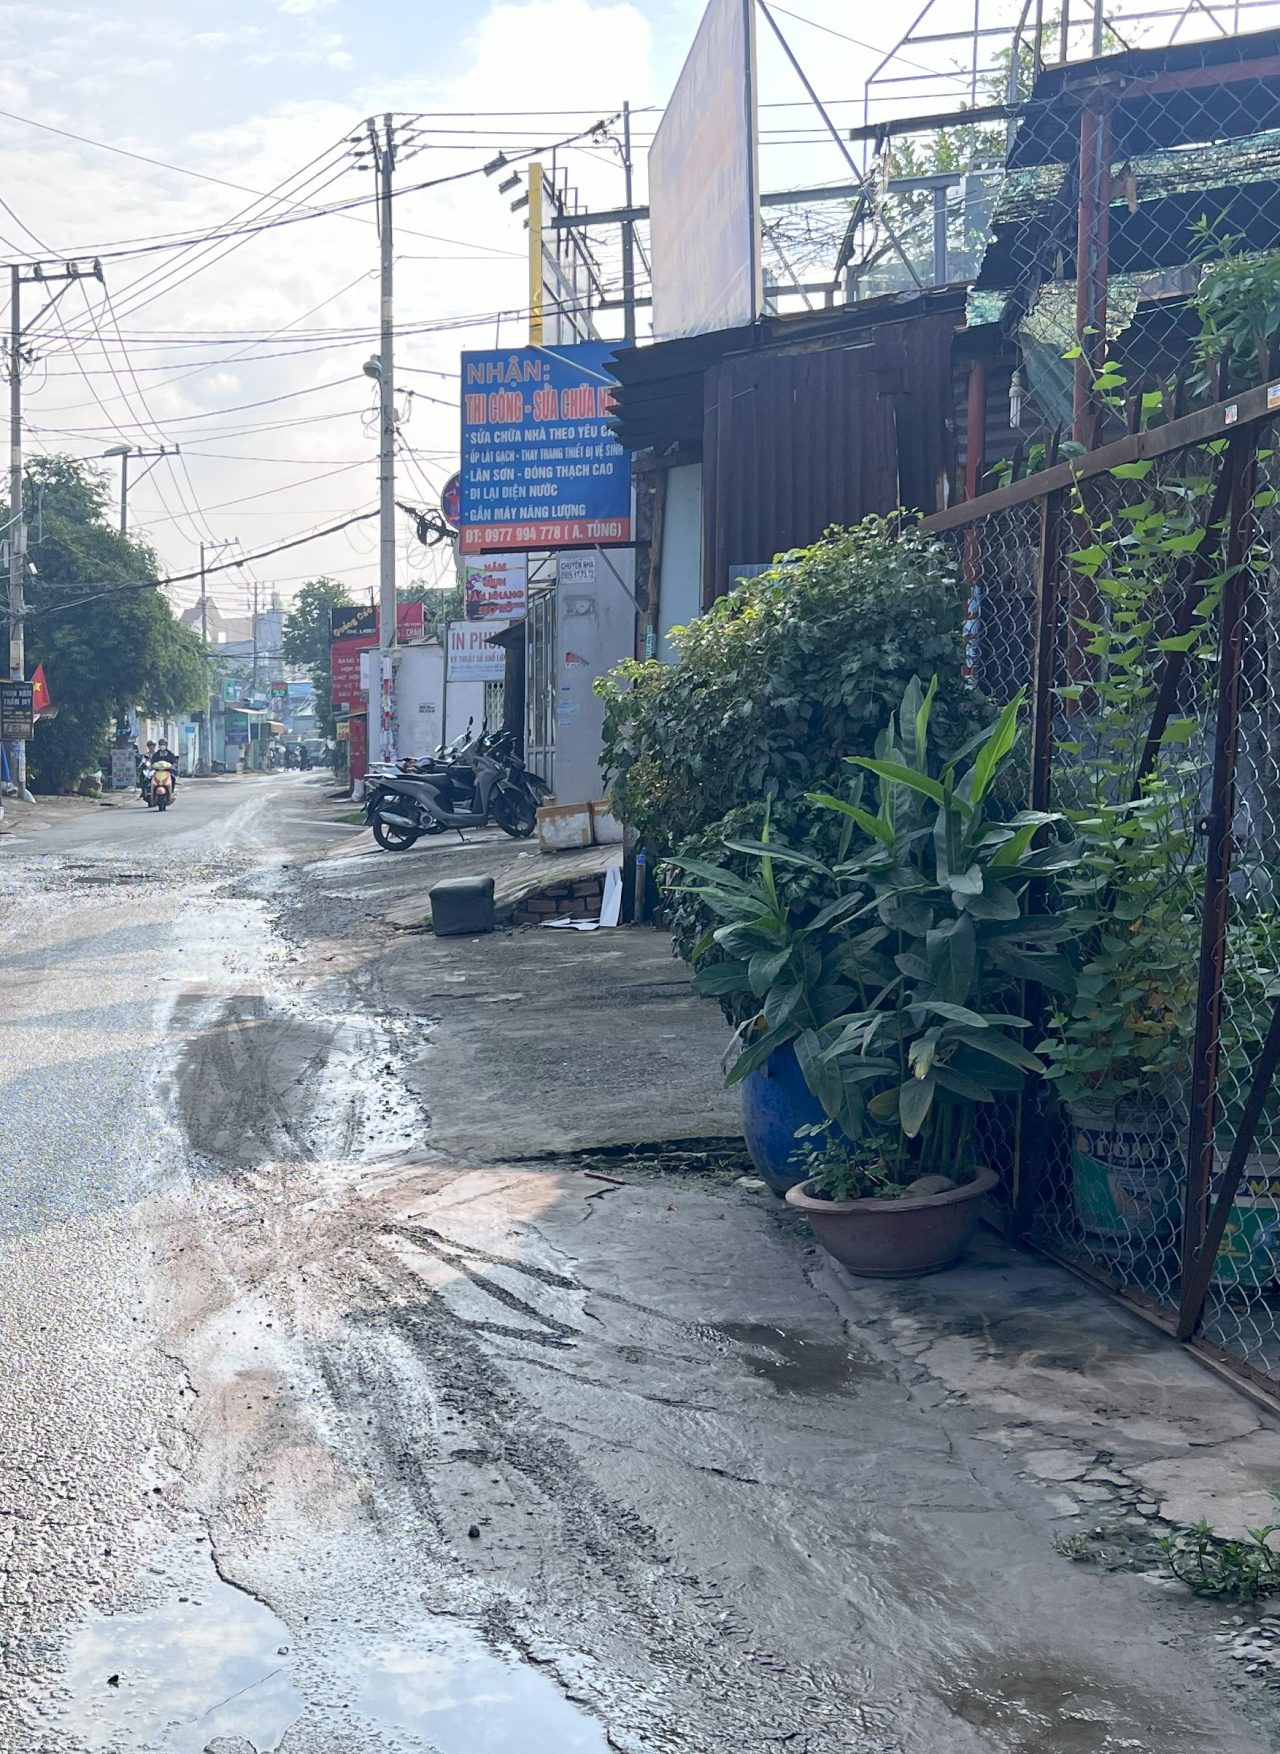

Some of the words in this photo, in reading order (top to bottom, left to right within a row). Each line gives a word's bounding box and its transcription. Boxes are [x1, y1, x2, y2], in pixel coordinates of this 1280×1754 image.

[467, 355, 550, 387] NHẬN:
[489, 387, 523, 424] CÔNG
[533, 383, 558, 422] SỬA
[561, 383, 595, 420] CHỮA
[470, 427, 491, 444] SỬA
[494, 427, 521, 443] CHỮA
[524, 424, 545, 441] NHÀ
[549, 427, 575, 440] THEO
[578, 423, 597, 438] YÊU
[521, 449, 538, 461] THAY
[493, 468, 514, 481] SƠN
[556, 464, 589, 480] THẠCH
[592, 462, 613, 476] CAO
[483, 486, 499, 501] LẠI
[529, 482, 558, 498] NƯỚC
[494, 506, 517, 520] MÁY
[520, 504, 549, 519] NĂNG
[551, 503, 586, 519] LƯỢNG
[484, 527, 512, 543] 0977
[516, 526, 536, 541] 994
[540, 525, 562, 540] 778
[572, 525, 583, 538] A.
[452, 632, 465, 650] IN
